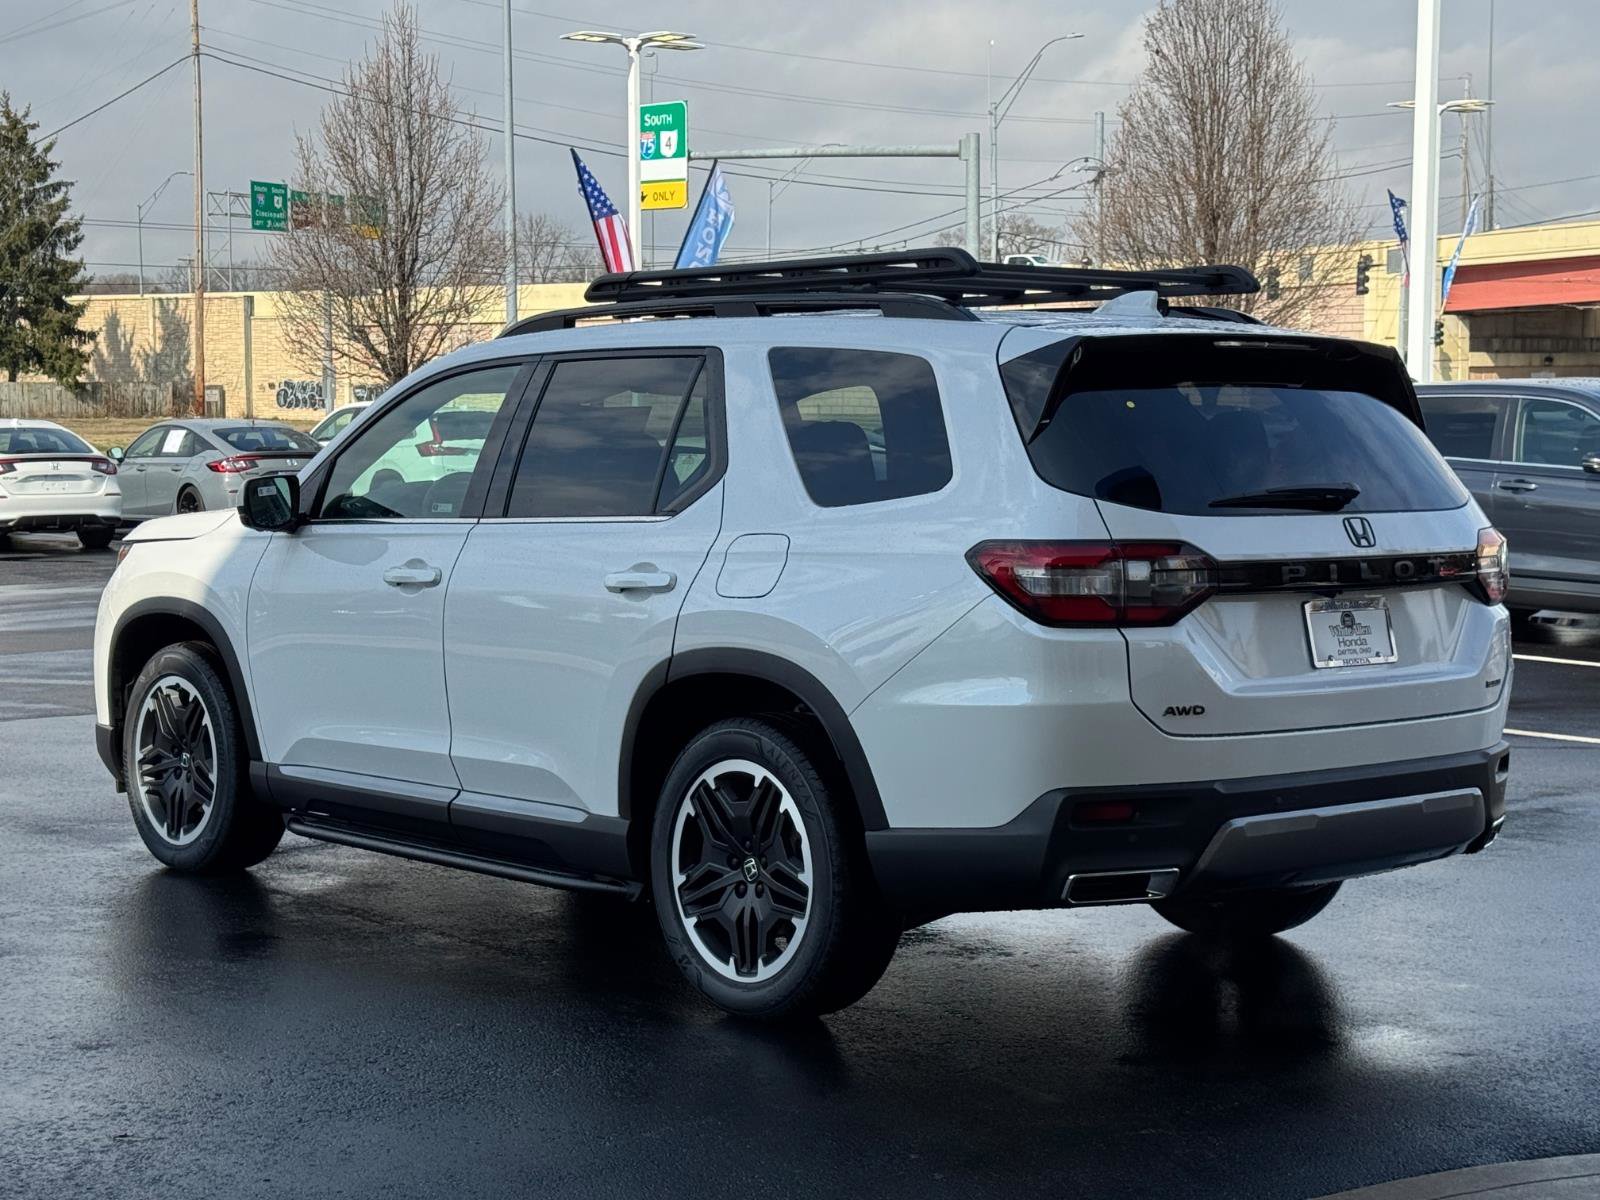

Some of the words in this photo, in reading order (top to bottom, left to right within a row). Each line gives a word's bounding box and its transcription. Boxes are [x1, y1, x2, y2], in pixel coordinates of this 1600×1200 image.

[644, 113, 673, 127] SOUTH
[641, 138, 655, 154] 75
[665, 136, 672, 150] 4
[652, 190, 676, 202] ONLY
[1281, 557, 1445, 583] PILOT
[1337, 636, 1368, 648] Honda
[1162, 704, 1206, 717] AWD
